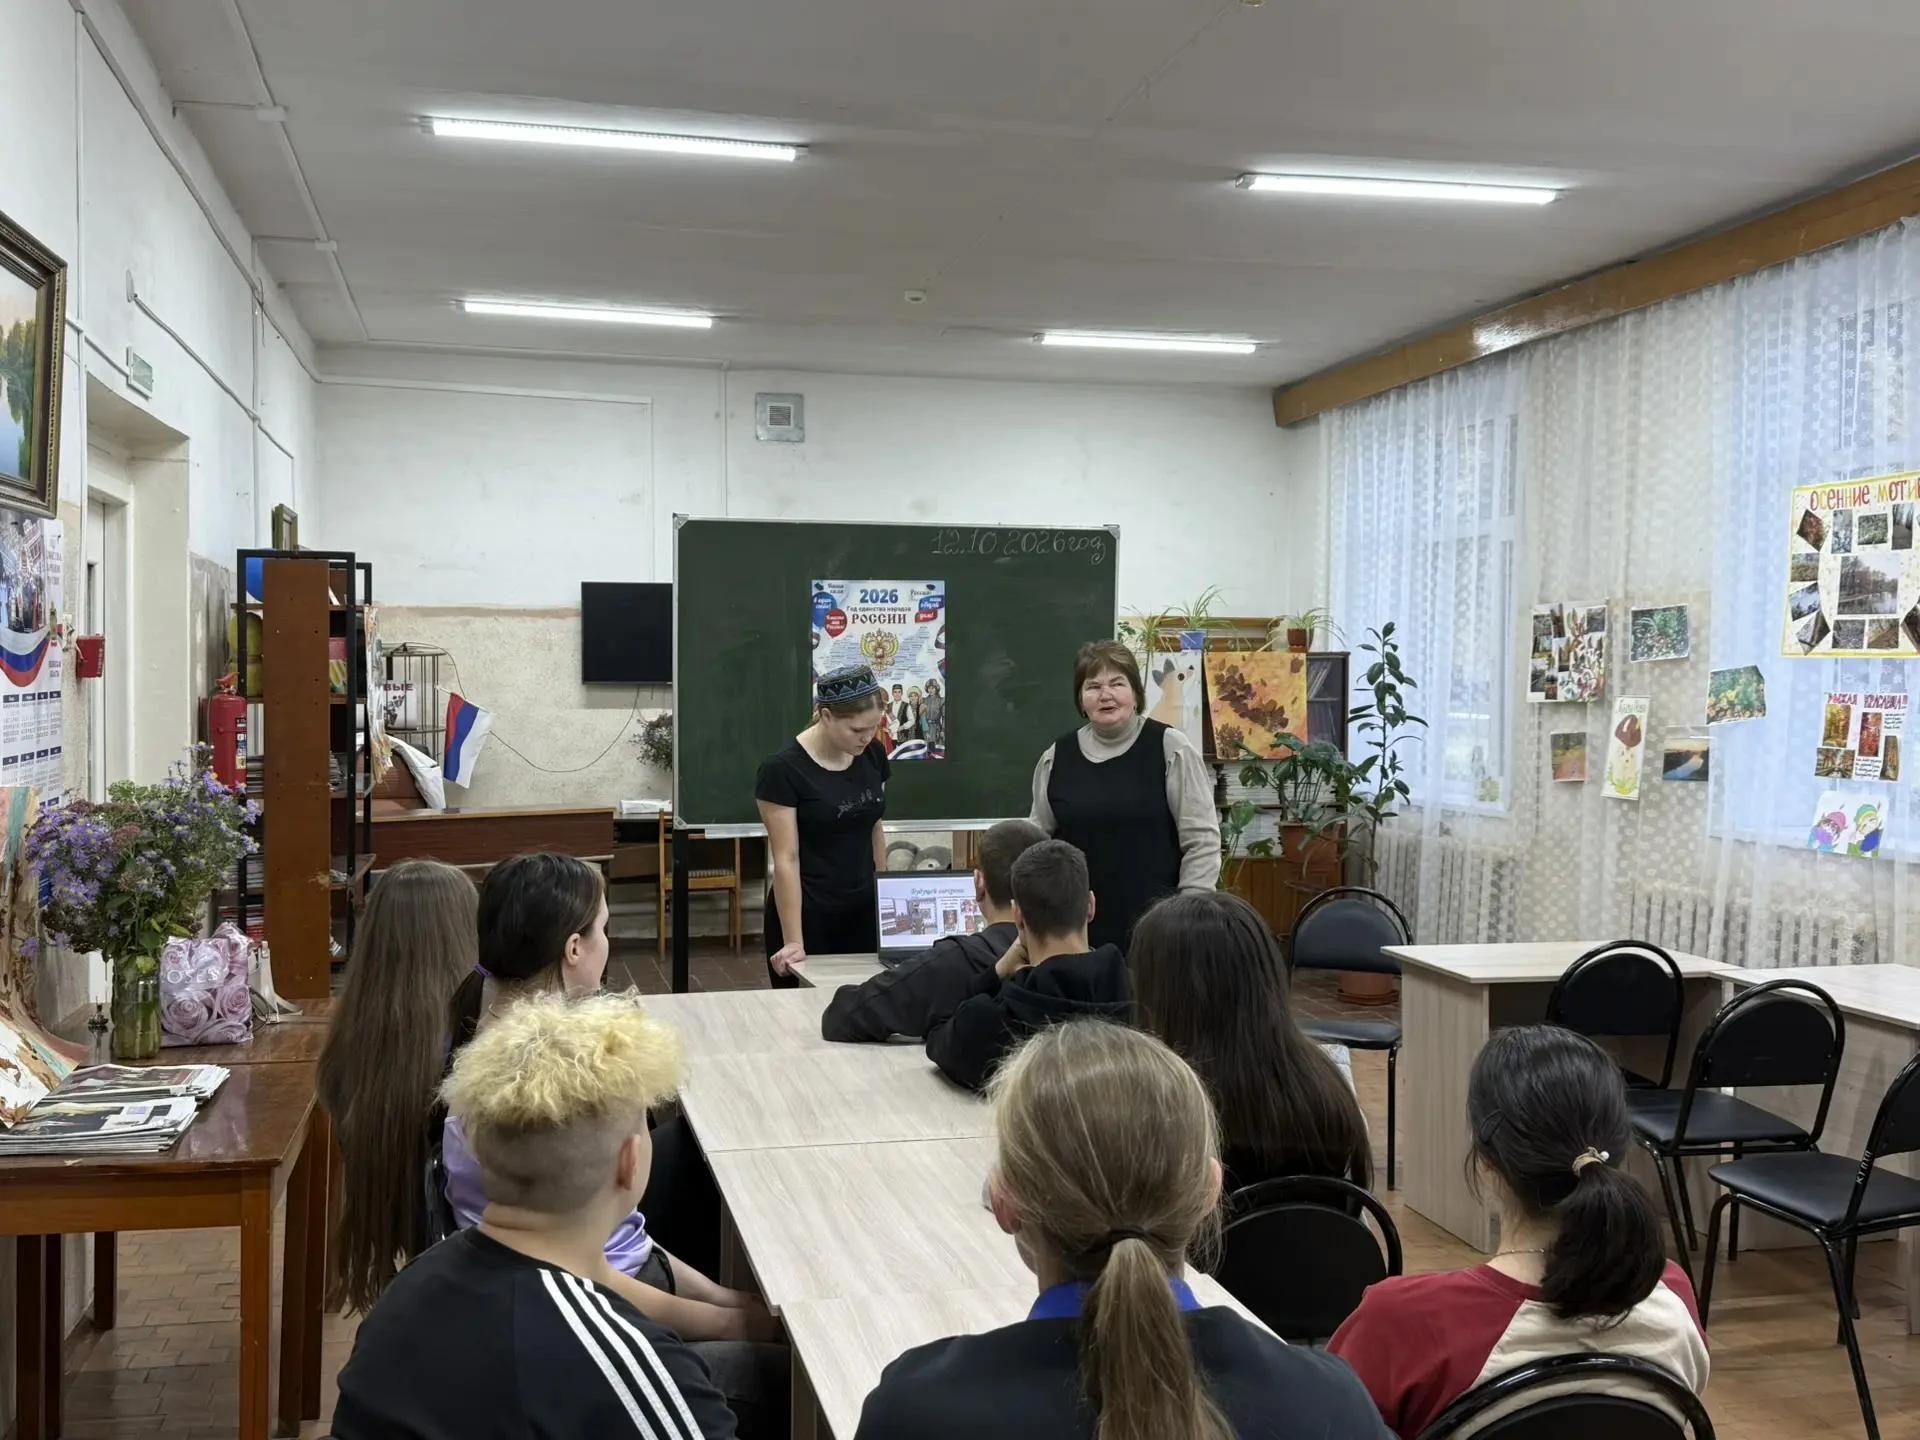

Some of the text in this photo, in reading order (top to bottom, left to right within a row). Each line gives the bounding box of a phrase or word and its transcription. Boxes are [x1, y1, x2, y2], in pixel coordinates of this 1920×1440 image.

[859, 588, 899, 603] 2026
[851, 613, 907, 624] РОССИИ
[383, 683, 413, 691] ВЫЕ
[167, 967, 220, 984] OSES
